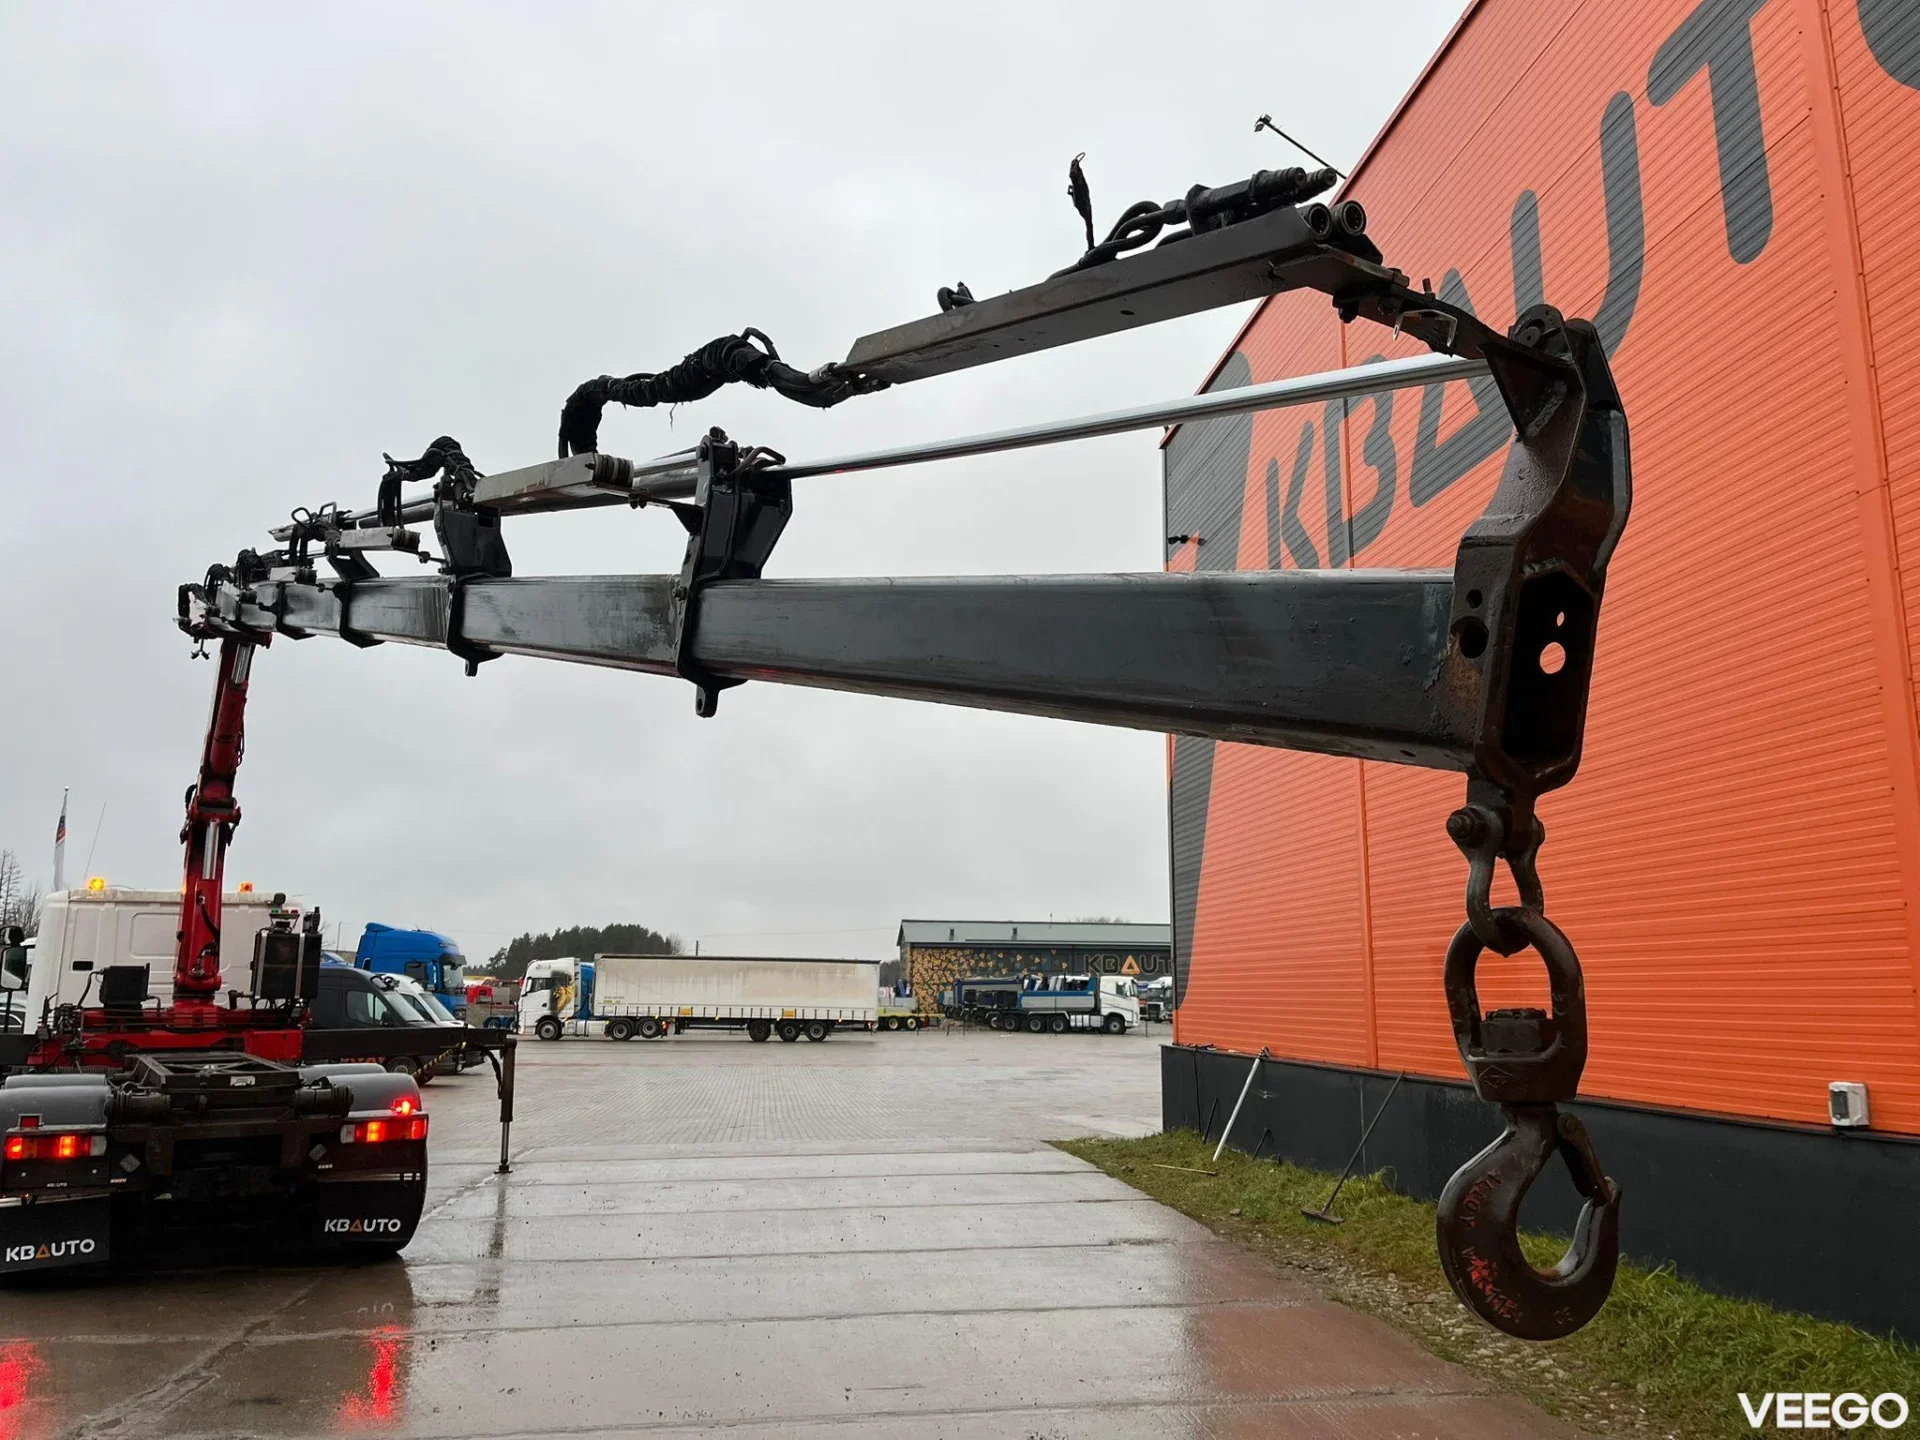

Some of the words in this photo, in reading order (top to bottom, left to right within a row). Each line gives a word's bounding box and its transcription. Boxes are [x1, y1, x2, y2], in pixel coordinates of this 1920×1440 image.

[1265, 0, 1920, 571] KBAUT
[324, 1218, 401, 1232] KBAUTO
[5, 1238, 95, 1262] KBAUTO
